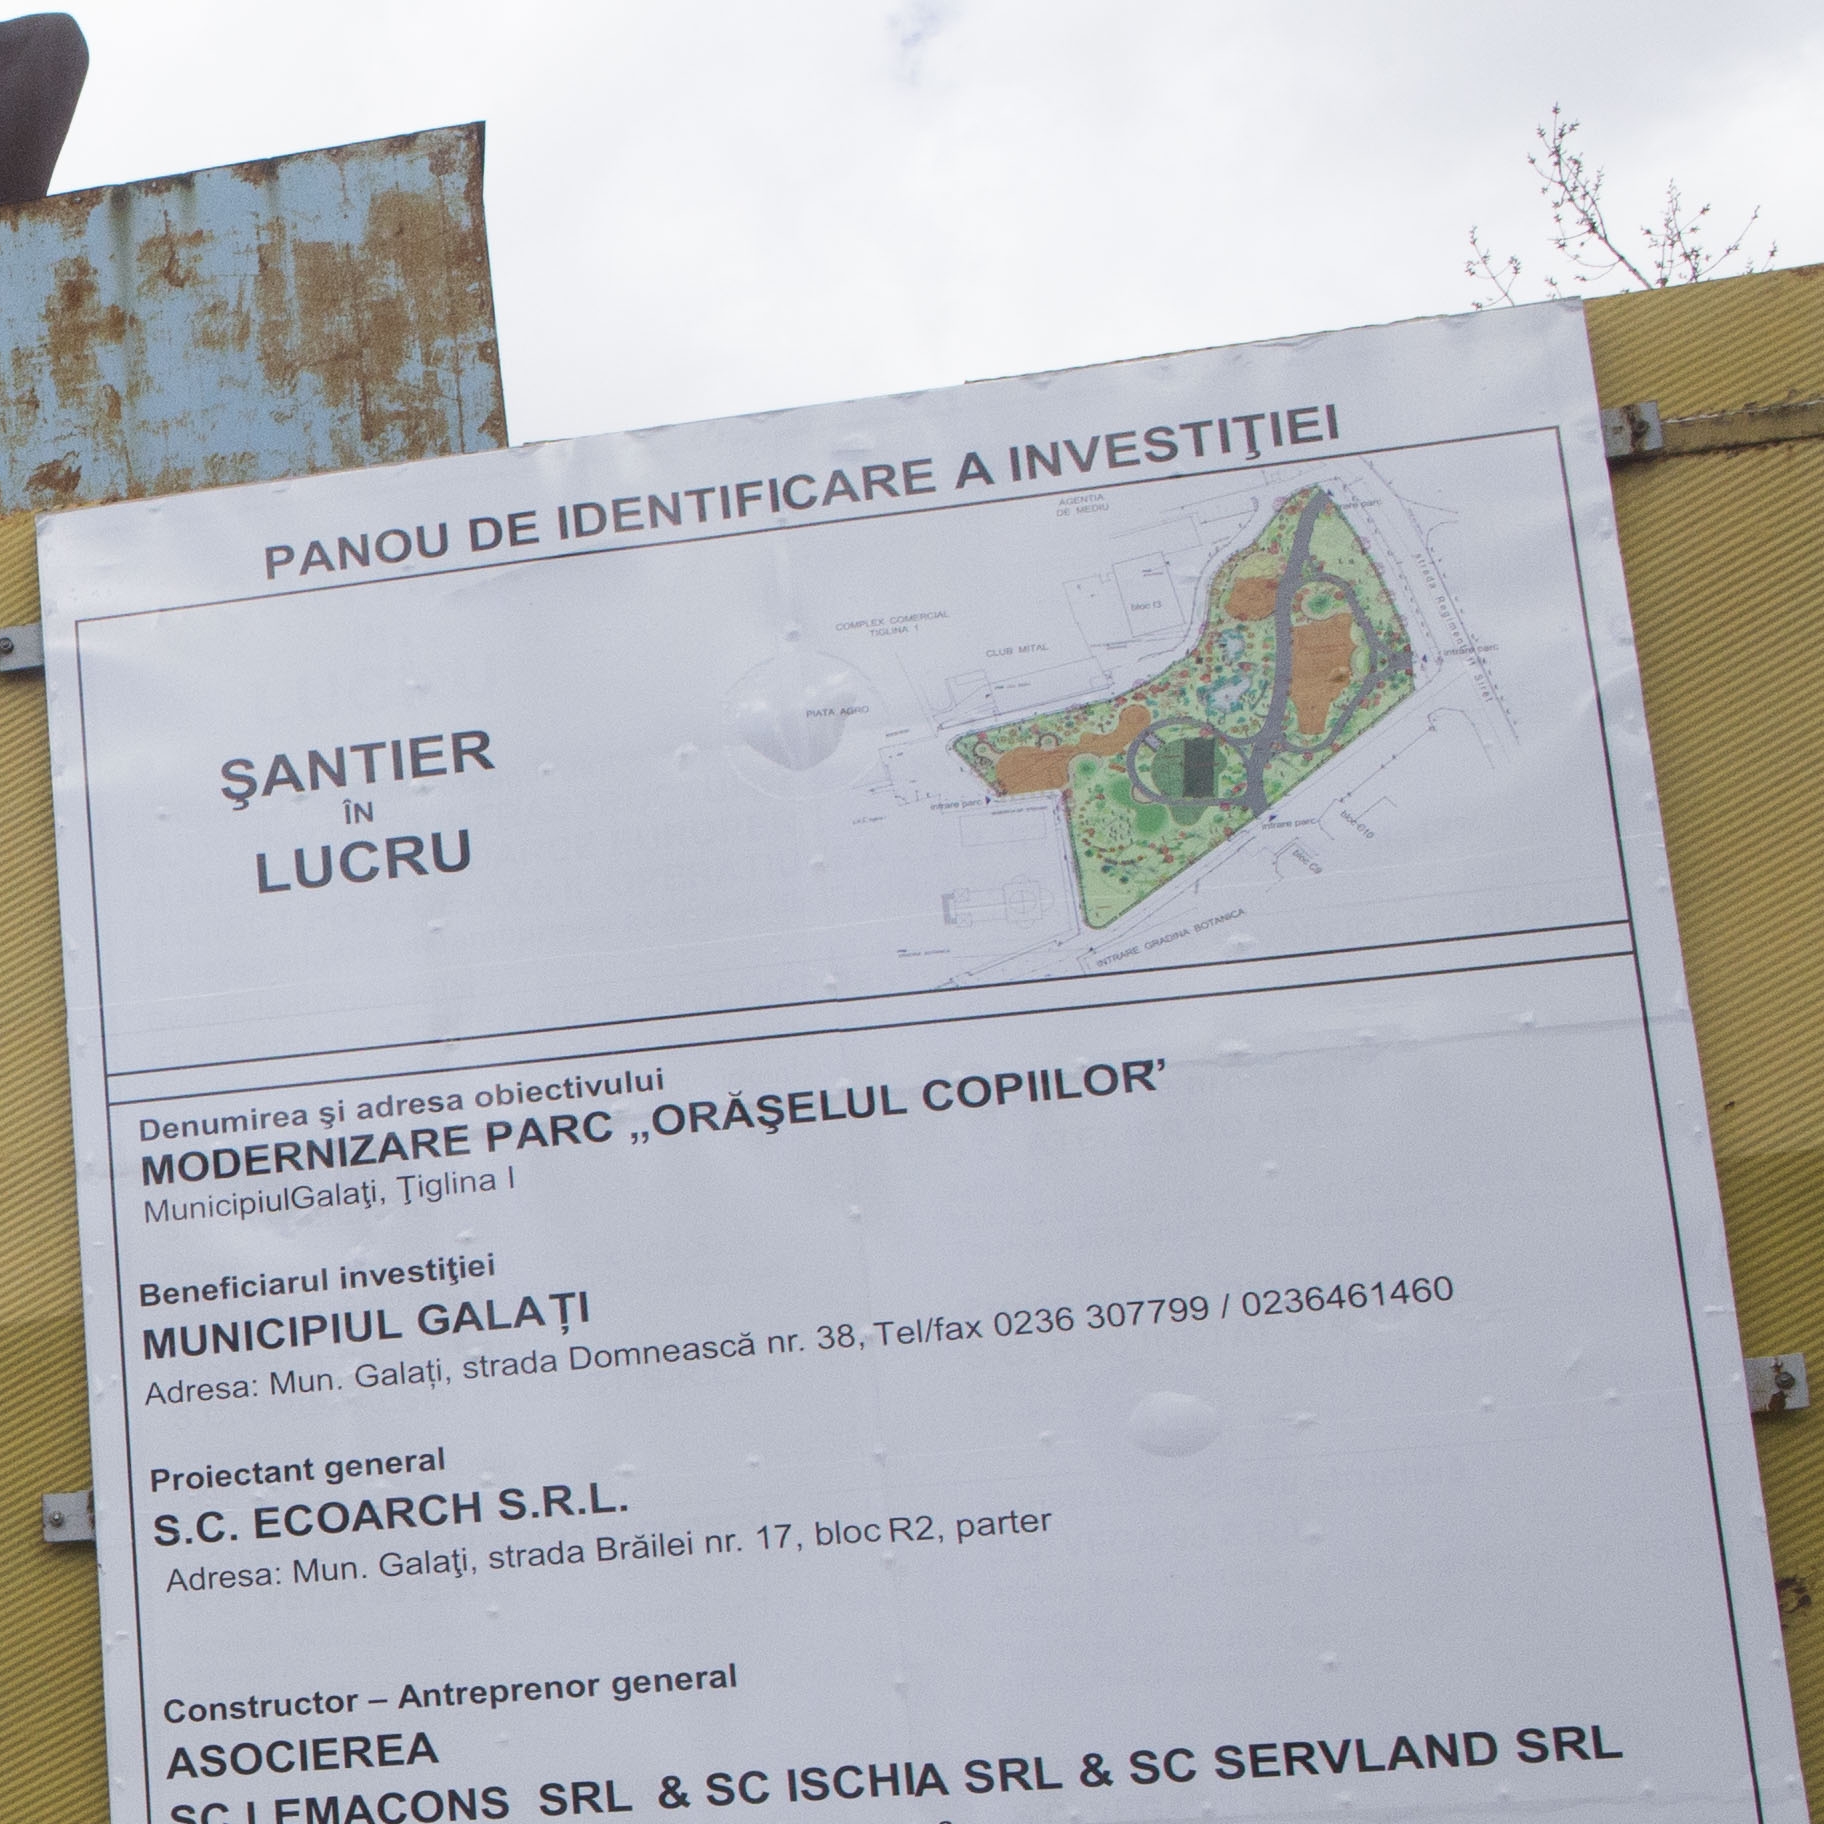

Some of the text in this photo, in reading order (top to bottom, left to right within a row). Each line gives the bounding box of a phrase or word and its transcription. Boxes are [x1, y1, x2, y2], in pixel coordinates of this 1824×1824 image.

[265, 521, 449, 580] PANOU
[468, 509, 541, 553] DE
[557, 457, 937, 541] IDENTIFICARE
[955, 450, 996, 490] A
[835, 617, 885, 632] COMPLEX
[985, 646, 1015, 658] CLUB
[342, 798, 374, 825] ÎN
[255, 828, 471, 894] LUCRU
[1193, 907, 1246, 934] BOTANICA
[139, 1107, 309, 1142] Denumirea
[356, 1093, 464, 1121] adresa
[474, 1066, 664, 1109] obiectivului
[141, 1123, 472, 1187] MODERNIZARE
[485, 1110, 614, 1153] PARC
[139, 1267, 329, 1308] Beneficiarul
[142, 1308, 403, 1361] MUNICIPIUL
[144, 1378, 259, 1407] Adresa:
[269, 1369, 343, 1396] Mun.
[462, 1349, 558, 1380] strada
[568, 1331, 756, 1371] Domnească
[767, 1333, 805, 1355] nr.
[816, 1323, 865, 1351] 38,
[872, 1315, 984, 1347] Tel/fax
[993, 1306, 1075, 1337] 0236
[1085, 1295, 1210, 1330] 307799
[1241, 1275, 1454, 1318] 0236461460
[150, 1445, 446, 1493] Proiectant general
[153, 1481, 629, 1547] S.C. ECOARCH S.R.L.
[165, 1565, 282, 1594] Adresa:
[292, 1557, 367, 1584] Mun.
[488, 1539, 586, 1570] strada
[596, 1529, 694, 1563] Brăilei
[704, 1533, 743, 1555] nr.
[756, 1523, 803, 1552] 17,
[814, 1519, 882, 1547] bloc
[888, 1514, 944, 1544] R2,
[956, 1509, 1053, 1545] parter
[163, 1661, 738, 1725] Constructor Antreprenor general
[165, 1731, 441, 1781] ASOCIEREA
[538, 1779, 634, 1817] SRL
[657, 1774, 692, 1810] &
[705, 1769, 771, 1807] SC
[786, 1761, 951, 1803] ISCHIA
[964, 1756, 1064, 1795] SRL
[1079, 1752, 1115, 1789] &
[1129, 1747, 1198, 1786] SC
[1213, 1730, 1499, 1781] SERVLAND
[1515, 1724, 1624, 1765] SRL
